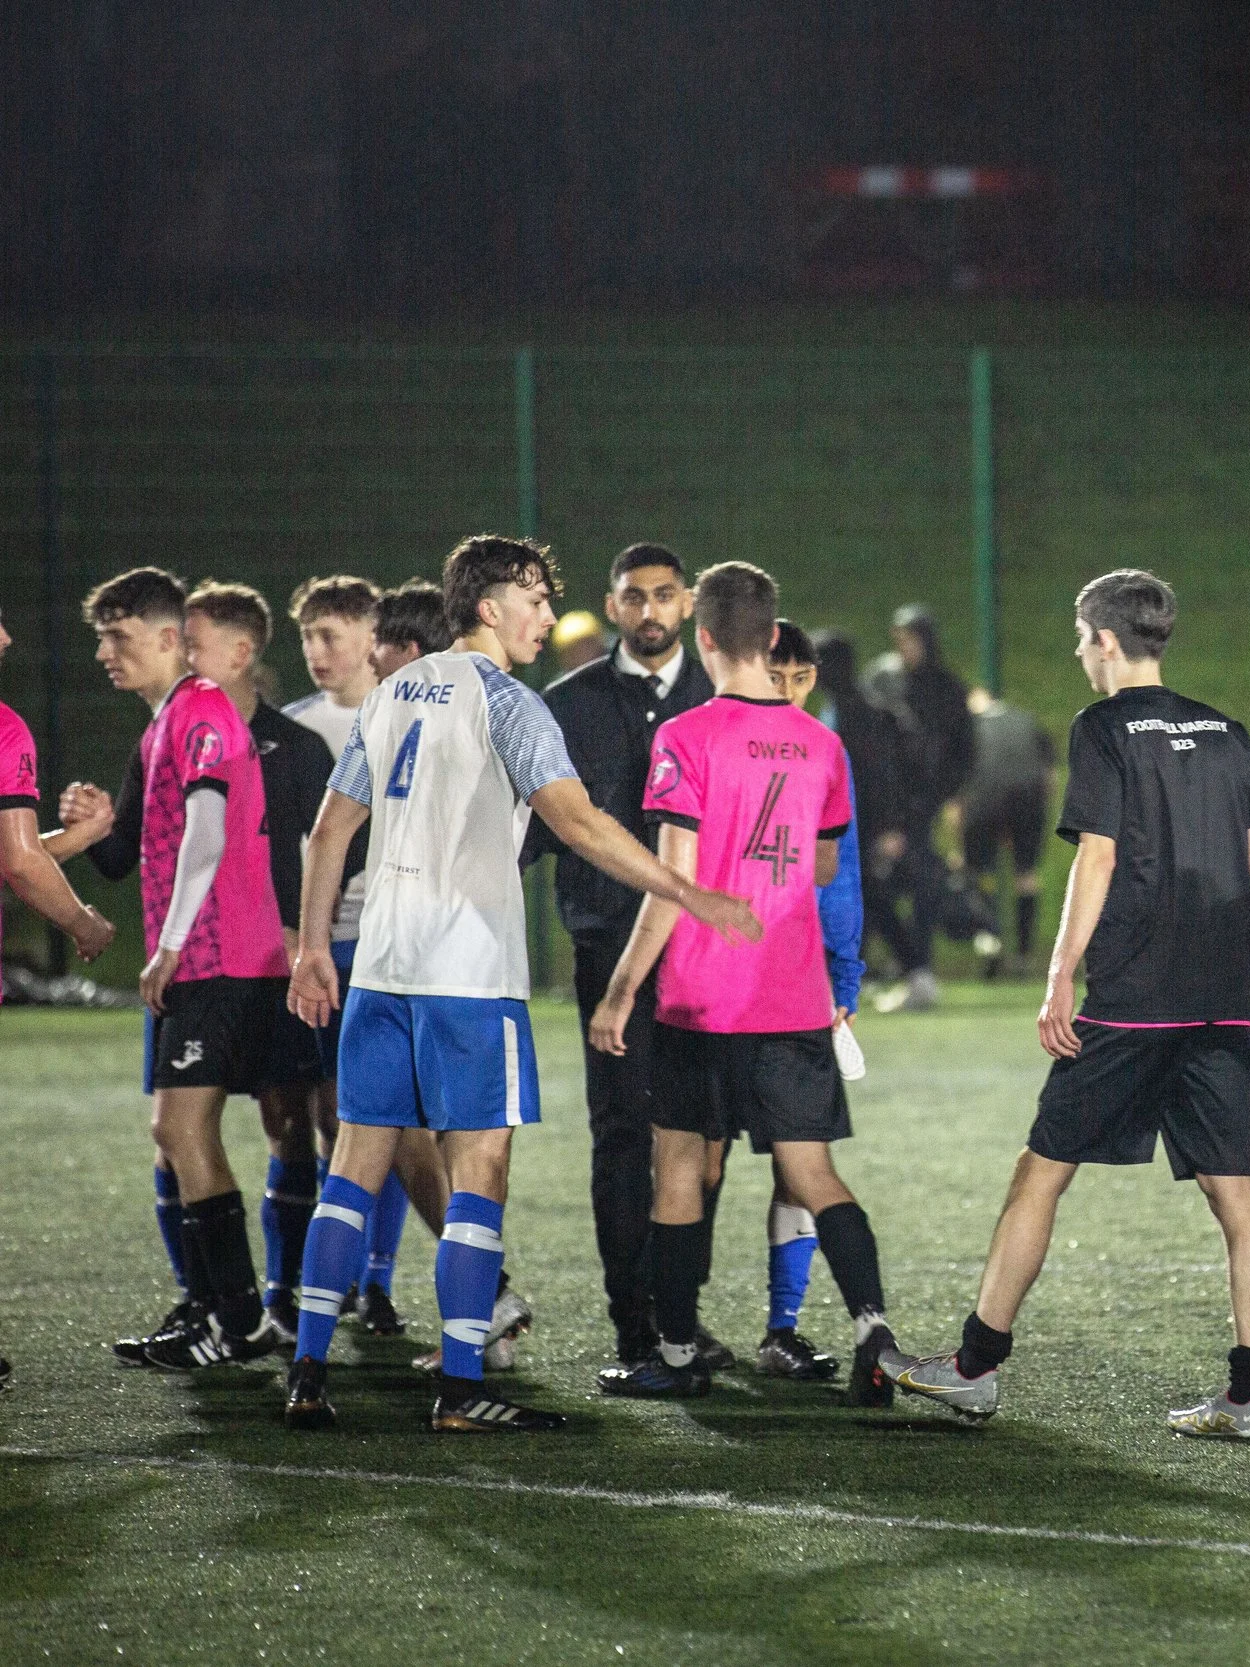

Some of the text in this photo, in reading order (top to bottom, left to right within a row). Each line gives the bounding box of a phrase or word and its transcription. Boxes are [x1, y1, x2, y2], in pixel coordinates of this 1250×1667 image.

[394, 680, 454, 705] WARE
[1126, 719, 1228, 734] FOOTBLL VARSITY
[748, 740, 807, 760] OWEN
[741, 772, 800, 887] 4
